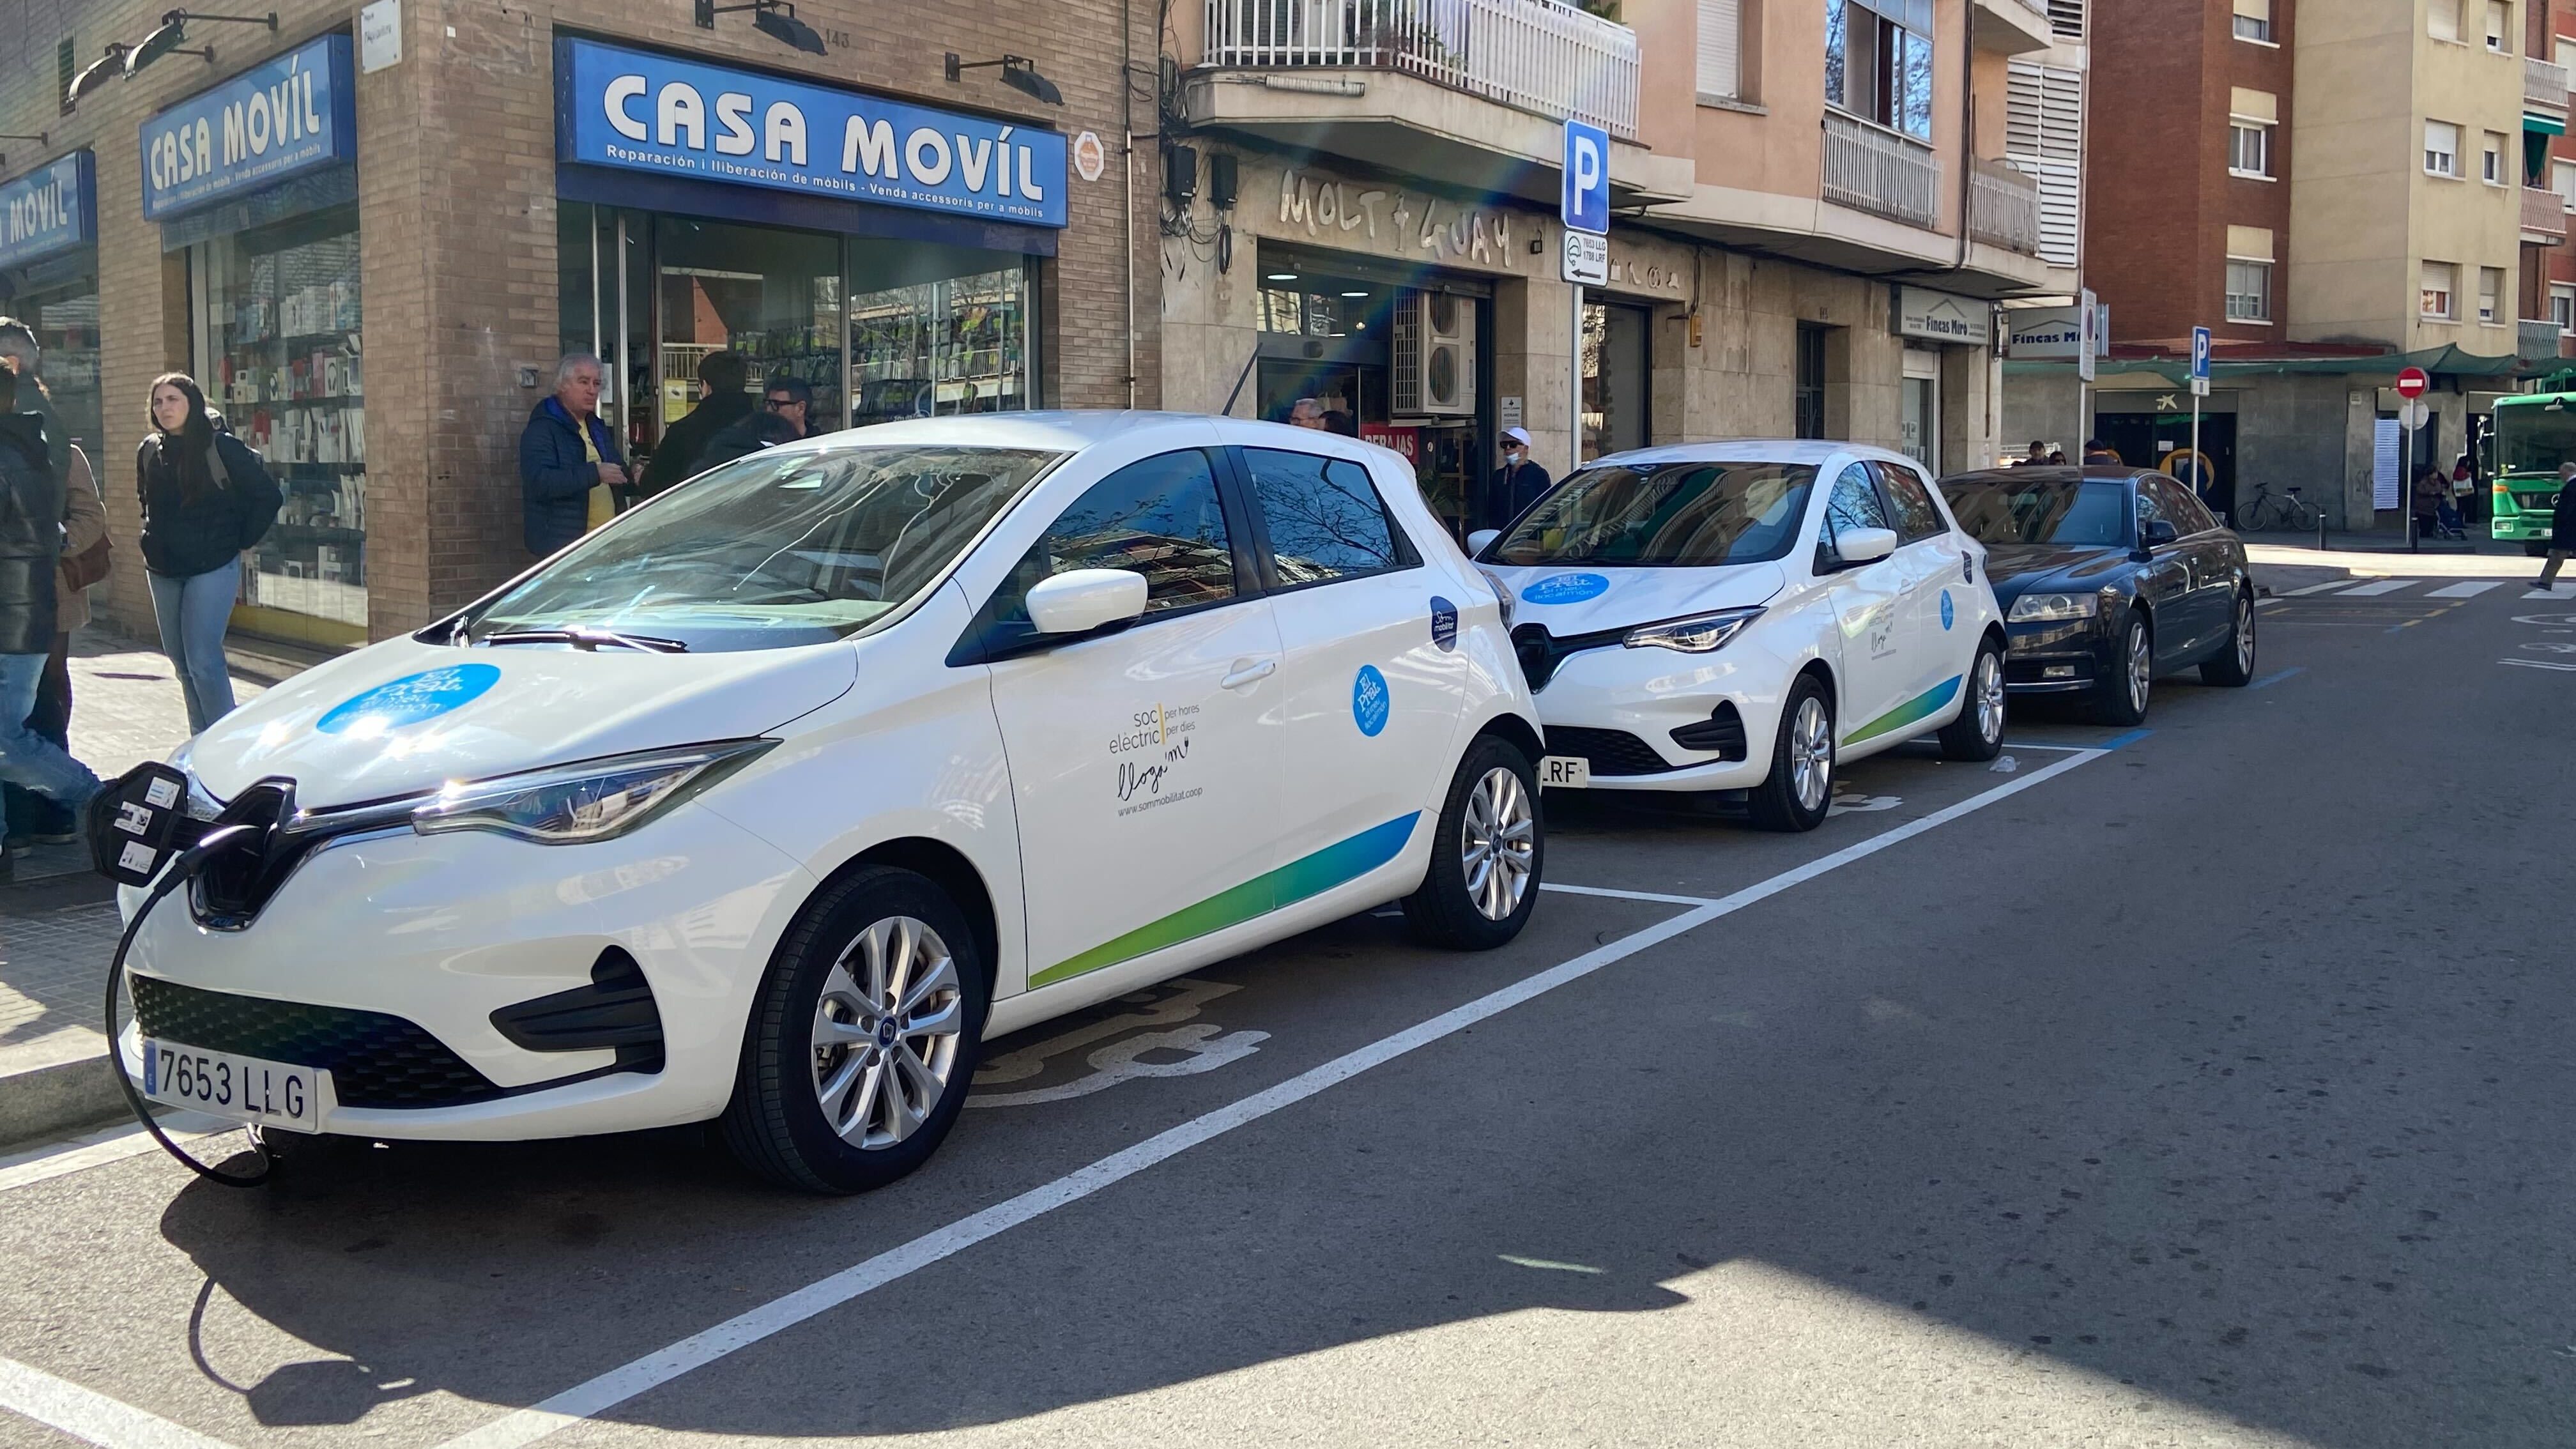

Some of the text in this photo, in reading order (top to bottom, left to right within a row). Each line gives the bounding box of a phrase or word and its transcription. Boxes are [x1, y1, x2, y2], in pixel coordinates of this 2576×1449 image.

[826, 28, 850, 49] 143
[150, 54, 319, 190] CASA MOVÍL
[604, 74, 808, 165] CASA
[841, 125, 1043, 202] MOVÍL
[606, 144, 695, 169] Reparación
[702, 160, 705, 171] i
[711, 160, 786, 182] lliberación
[792, 172, 808, 185] de
[813, 176, 855, 192] mòbils
[870, 183, 907, 199] Venda
[911, 192, 974, 208] accessoris
[977, 201, 994, 211] per
[999, 204, 1005, 213] a
[1009, 204, 1043, 218] mòbils
[1574, 135, 1600, 216] P
[10, 167, 68, 238] MOVÍL
[1280, 169, 1512, 268] MOLT GUAY
[1926, 315, 1950, 333] Fincas
[2012, 331, 2099, 344] Fincas Mi
[2196, 333, 2207, 372] P
[1359, 673, 1371, 694] El
[1133, 704, 1200, 728] soc per hores
[1166, 724, 1179, 739] per
[1180, 720, 1196, 733] dies
[1543, 761, 1577, 783] RF
[1117, 786, 1204, 817] www.sommobilitat.coop
[160, 1049, 304, 1119] 7653 LLG
